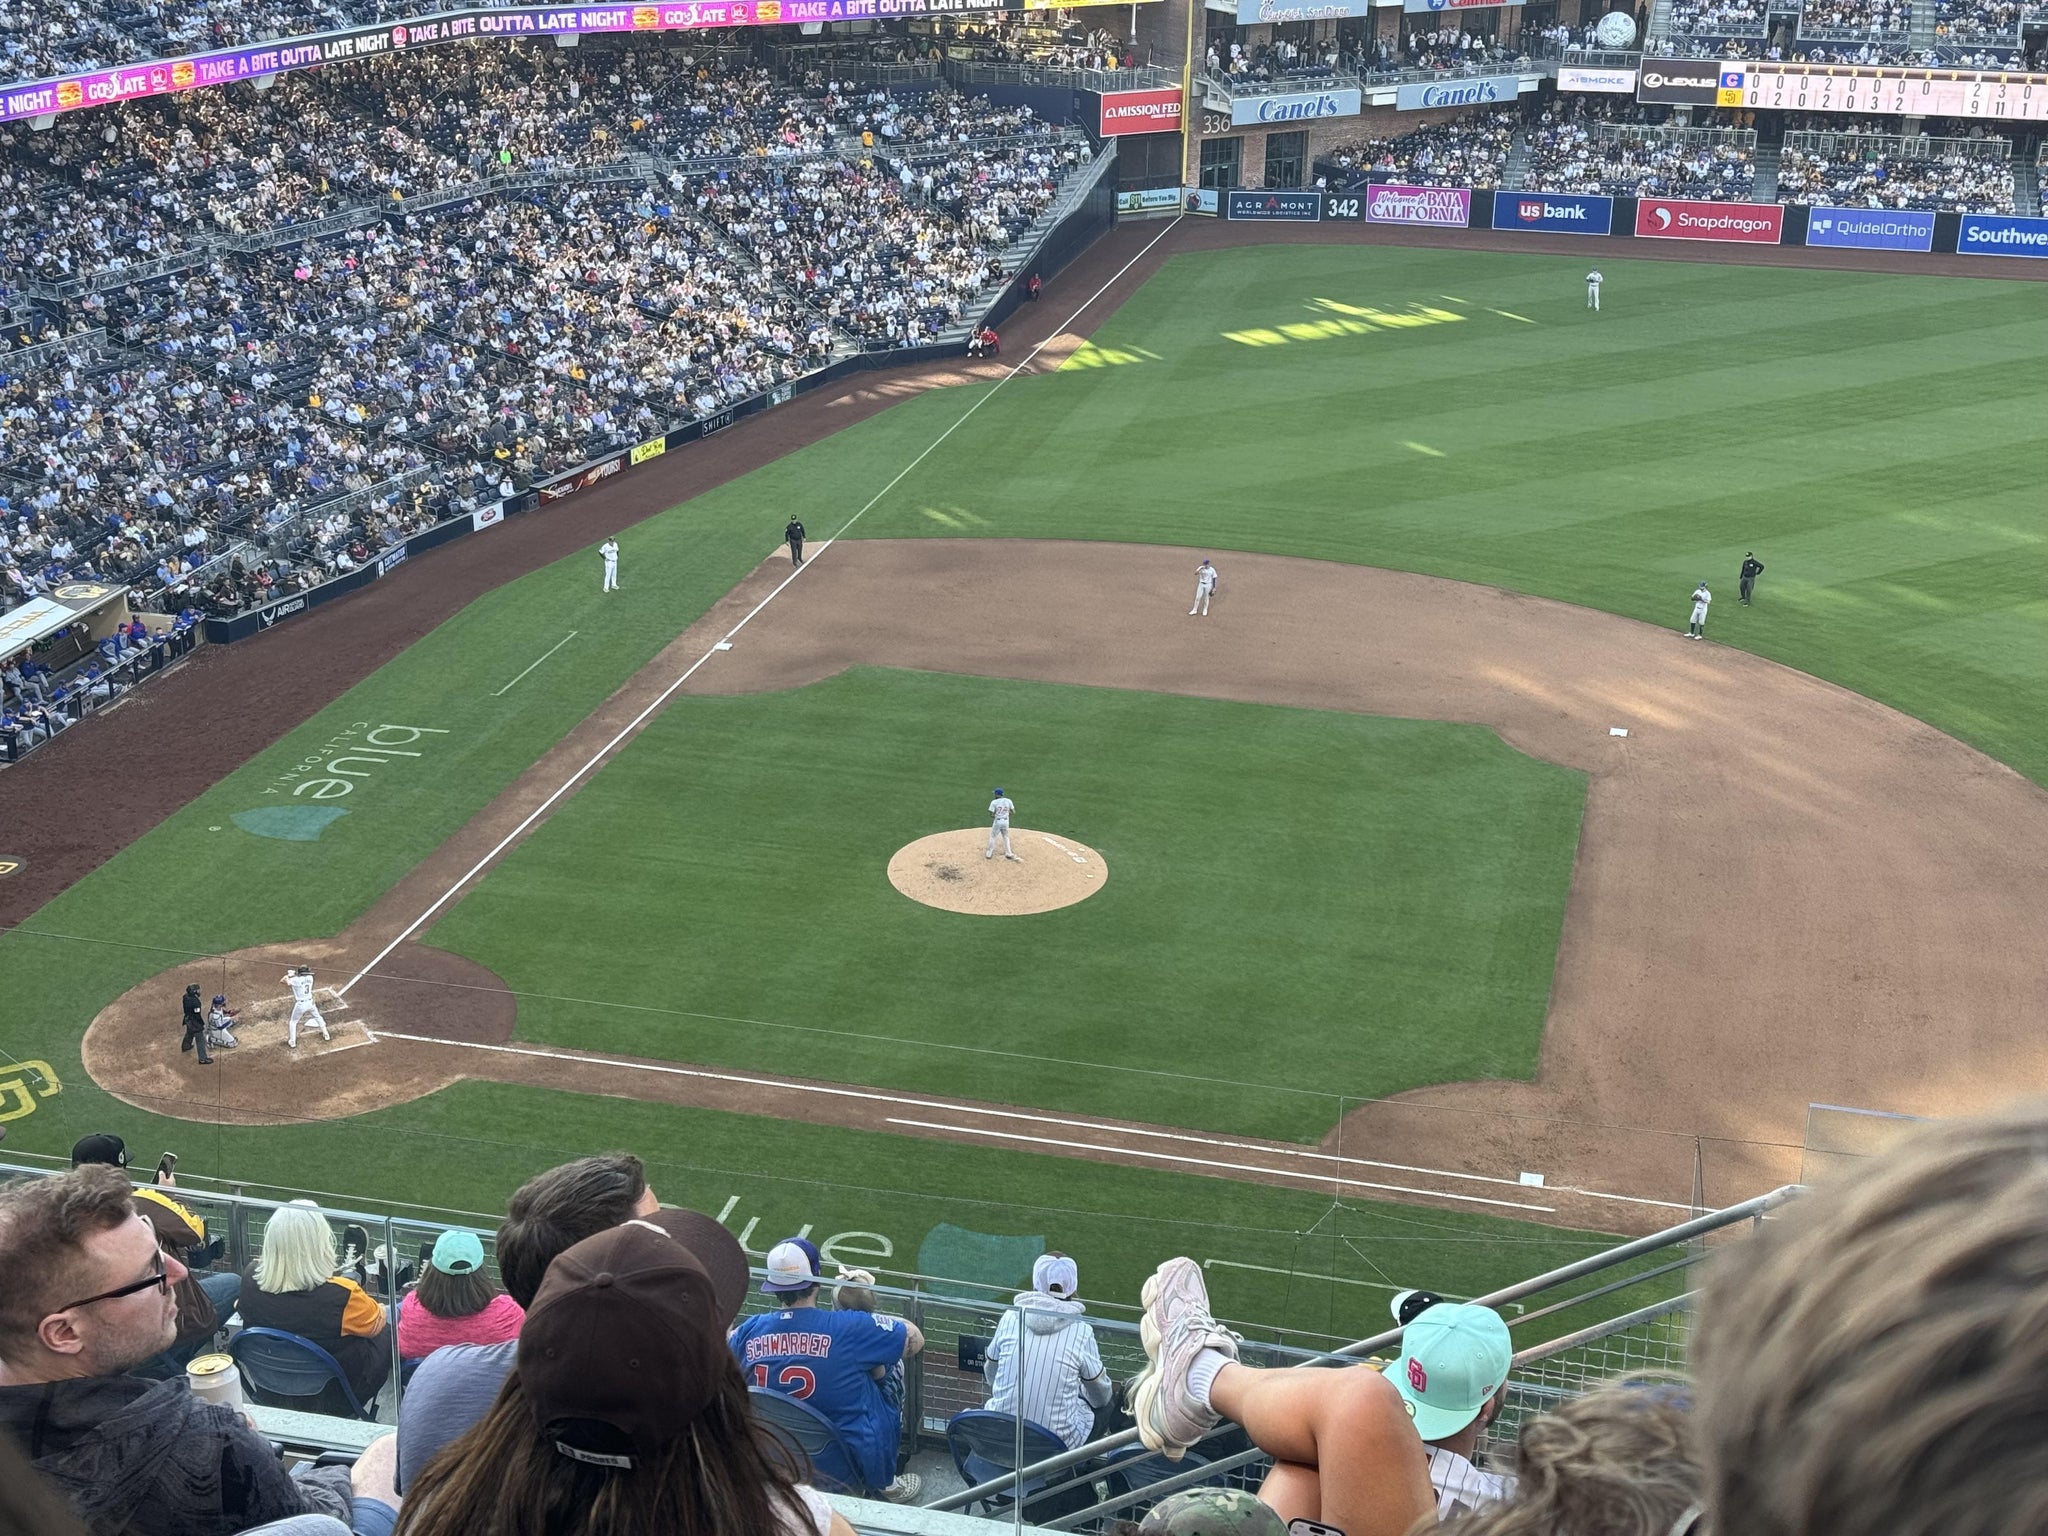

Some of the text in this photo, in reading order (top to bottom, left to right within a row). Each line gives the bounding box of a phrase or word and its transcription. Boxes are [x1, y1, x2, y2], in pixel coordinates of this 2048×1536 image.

[790, 2, 827, 18] TAKE
[831, 2, 842, 16] A
[846, 0, 876, 15] BITE
[879, 0, 926, 12] OUTTA
[929, 0, 963, 10] LATE
[409, 23, 439, 43] TAKE
[441, 22, 450, 38] A
[451, 17, 475, 36] BITE
[479, 15, 535, 32] OUTTA
[538, 13, 577, 30] LATE
[581, 11, 627, 28] NIGHT
[200, 59, 235, 81] TAKE
[239, 57, 249, 74] A
[251, 52, 279, 72] BITE
[281, 45, 322, 65] OUTTA
[324, 39, 353, 59] LATE
[355, 33, 390, 54] NIGHT
[1663, 77, 1717, 88] LEXUS
[1779, 65, 1785, 74] 2
[1803, 65, 1810, 75] 3
[1828, 66, 1834, 76] 4
[1902, 69, 1908, 79] 7
[1951, 71, 1958, 81] 9
[2001, 73, 2008, 83] H
[1421, 80, 1498, 107] Canel's
[1752, 74, 1760, 88] 0
[1776, 75, 1784, 90] 0
[1800, 76, 1808, 90] 0
[1824, 77, 1833, 91] 2
[1849, 78, 1857, 92] 0
[1873, 79, 1881, 93] 0
[1897, 80, 1906, 94] 0
[1922, 81, 1930, 96] 0
[1973, 83, 1982, 98] 2
[1998, 84, 2006, 99] 3
[2024, 85, 2032, 100] 0
[8, 90, 53, 115] NIGHT
[1118, 102, 1182, 117] MISSION FED
[1257, 94, 1340, 122] Canel's
[1750, 91, 1758, 105] 0
[1774, 92, 1782, 106] 2
[1798, 93, 1806, 107] 0
[1822, 94, 1830, 108] 2
[1846, 95, 1854, 109] 0
[1870, 96, 1878, 110] 3
[1895, 97, 1903, 111] 2
[1970, 100, 1979, 114] 9
[1995, 102, 2005, 116] 11
[2022, 102, 2028, 117] 1
[1202, 114, 1231, 134] 336
[1236, 196, 1313, 210] AGRAMONT
[1328, 198, 1359, 217] 342
[1377, 190, 1417, 204] Welcome
[1426, 191, 1464, 208] BAJA
[1370, 203, 1465, 223] CALIFORNIA
[1520, 202, 1585, 219] us bank
[1677, 212, 1772, 233] Snapdragon
[1837, 221, 1927, 238] QuidelOrtho
[277, 603, 290, 618] AIR
[260, 721, 368, 795] CALIFORNIA
[292, 723, 450, 800] blue
[304, 984, 310, 995] 3
[745, 1332, 832, 1363] SCHWARBER
[754, 1363, 816, 1401] 12
[1407, 1356, 1428, 1393] SD
